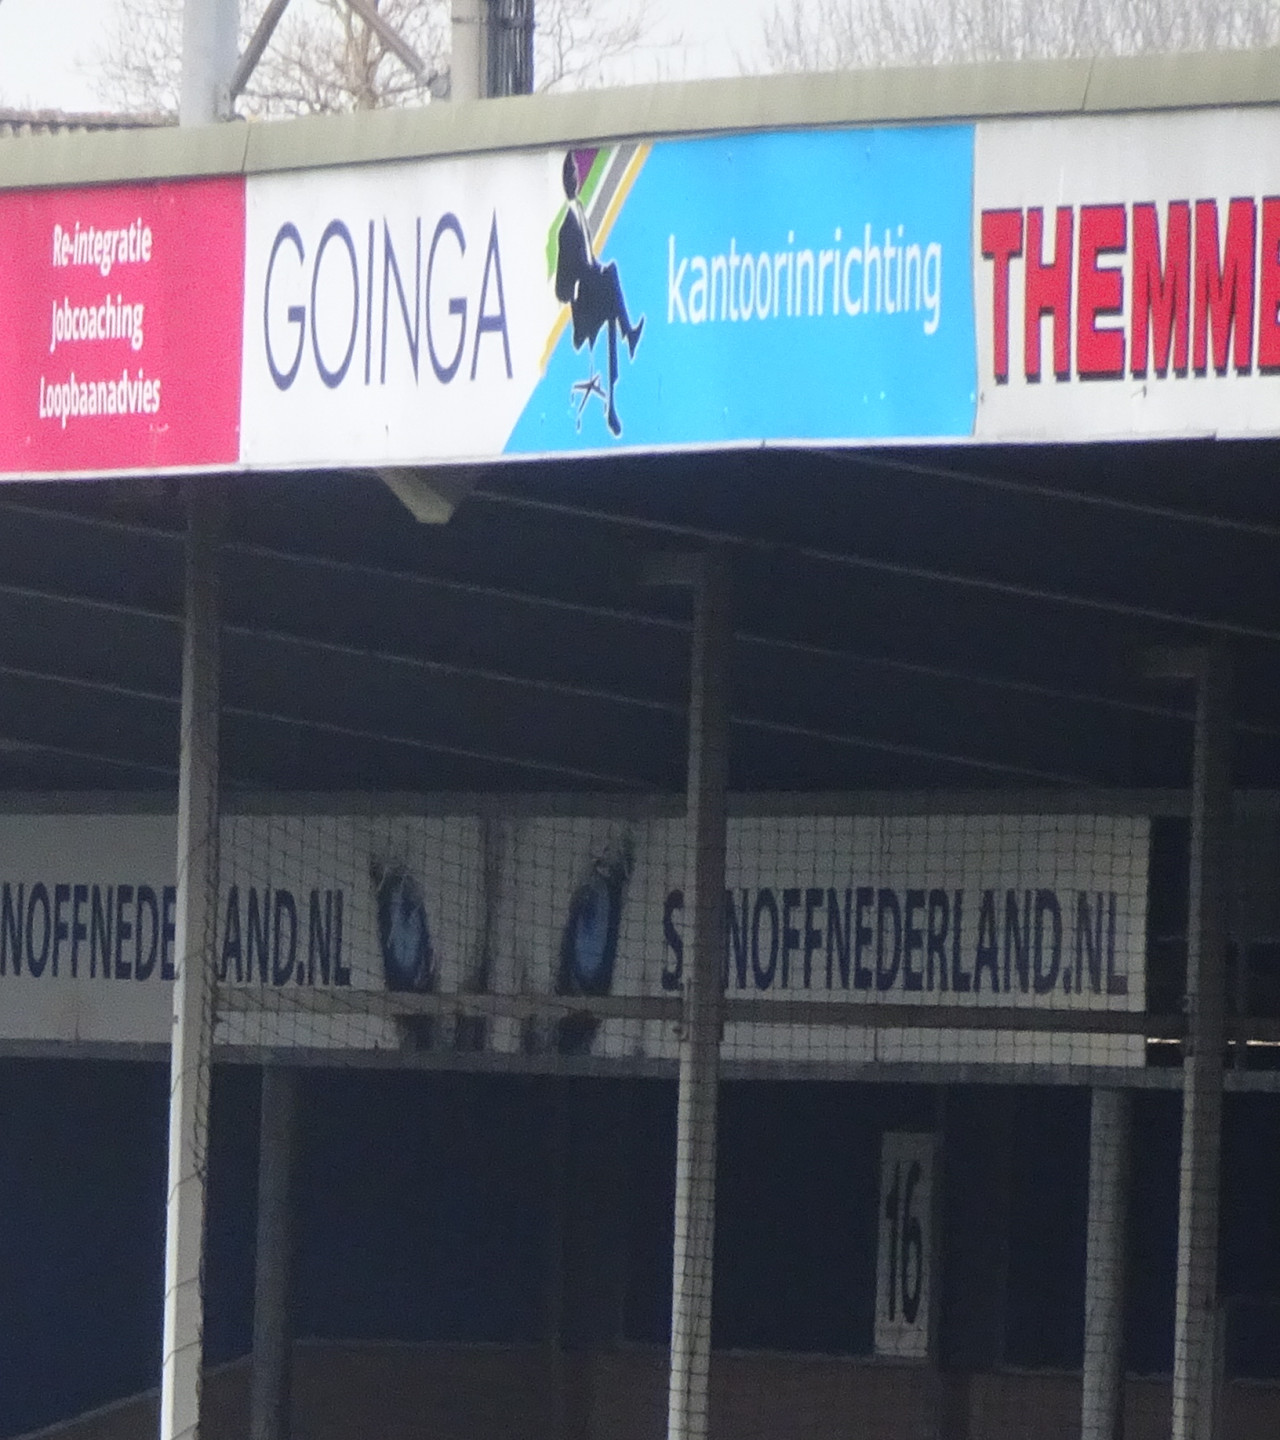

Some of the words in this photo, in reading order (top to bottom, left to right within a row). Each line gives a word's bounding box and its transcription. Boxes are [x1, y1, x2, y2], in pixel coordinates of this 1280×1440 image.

[52, 217, 153, 277] Re-integratie
[264, 211, 515, 392] GOINGA
[666, 223, 942, 337] kantoorinrichting
[50, 294, 144, 354] Jobcoaching
[39, 370, 162, 429] Loopbaanadvies
[662, 884, 1129, 996] SNOFFNEDERLAND.NL
[886, 1160, 922, 1325] 16
